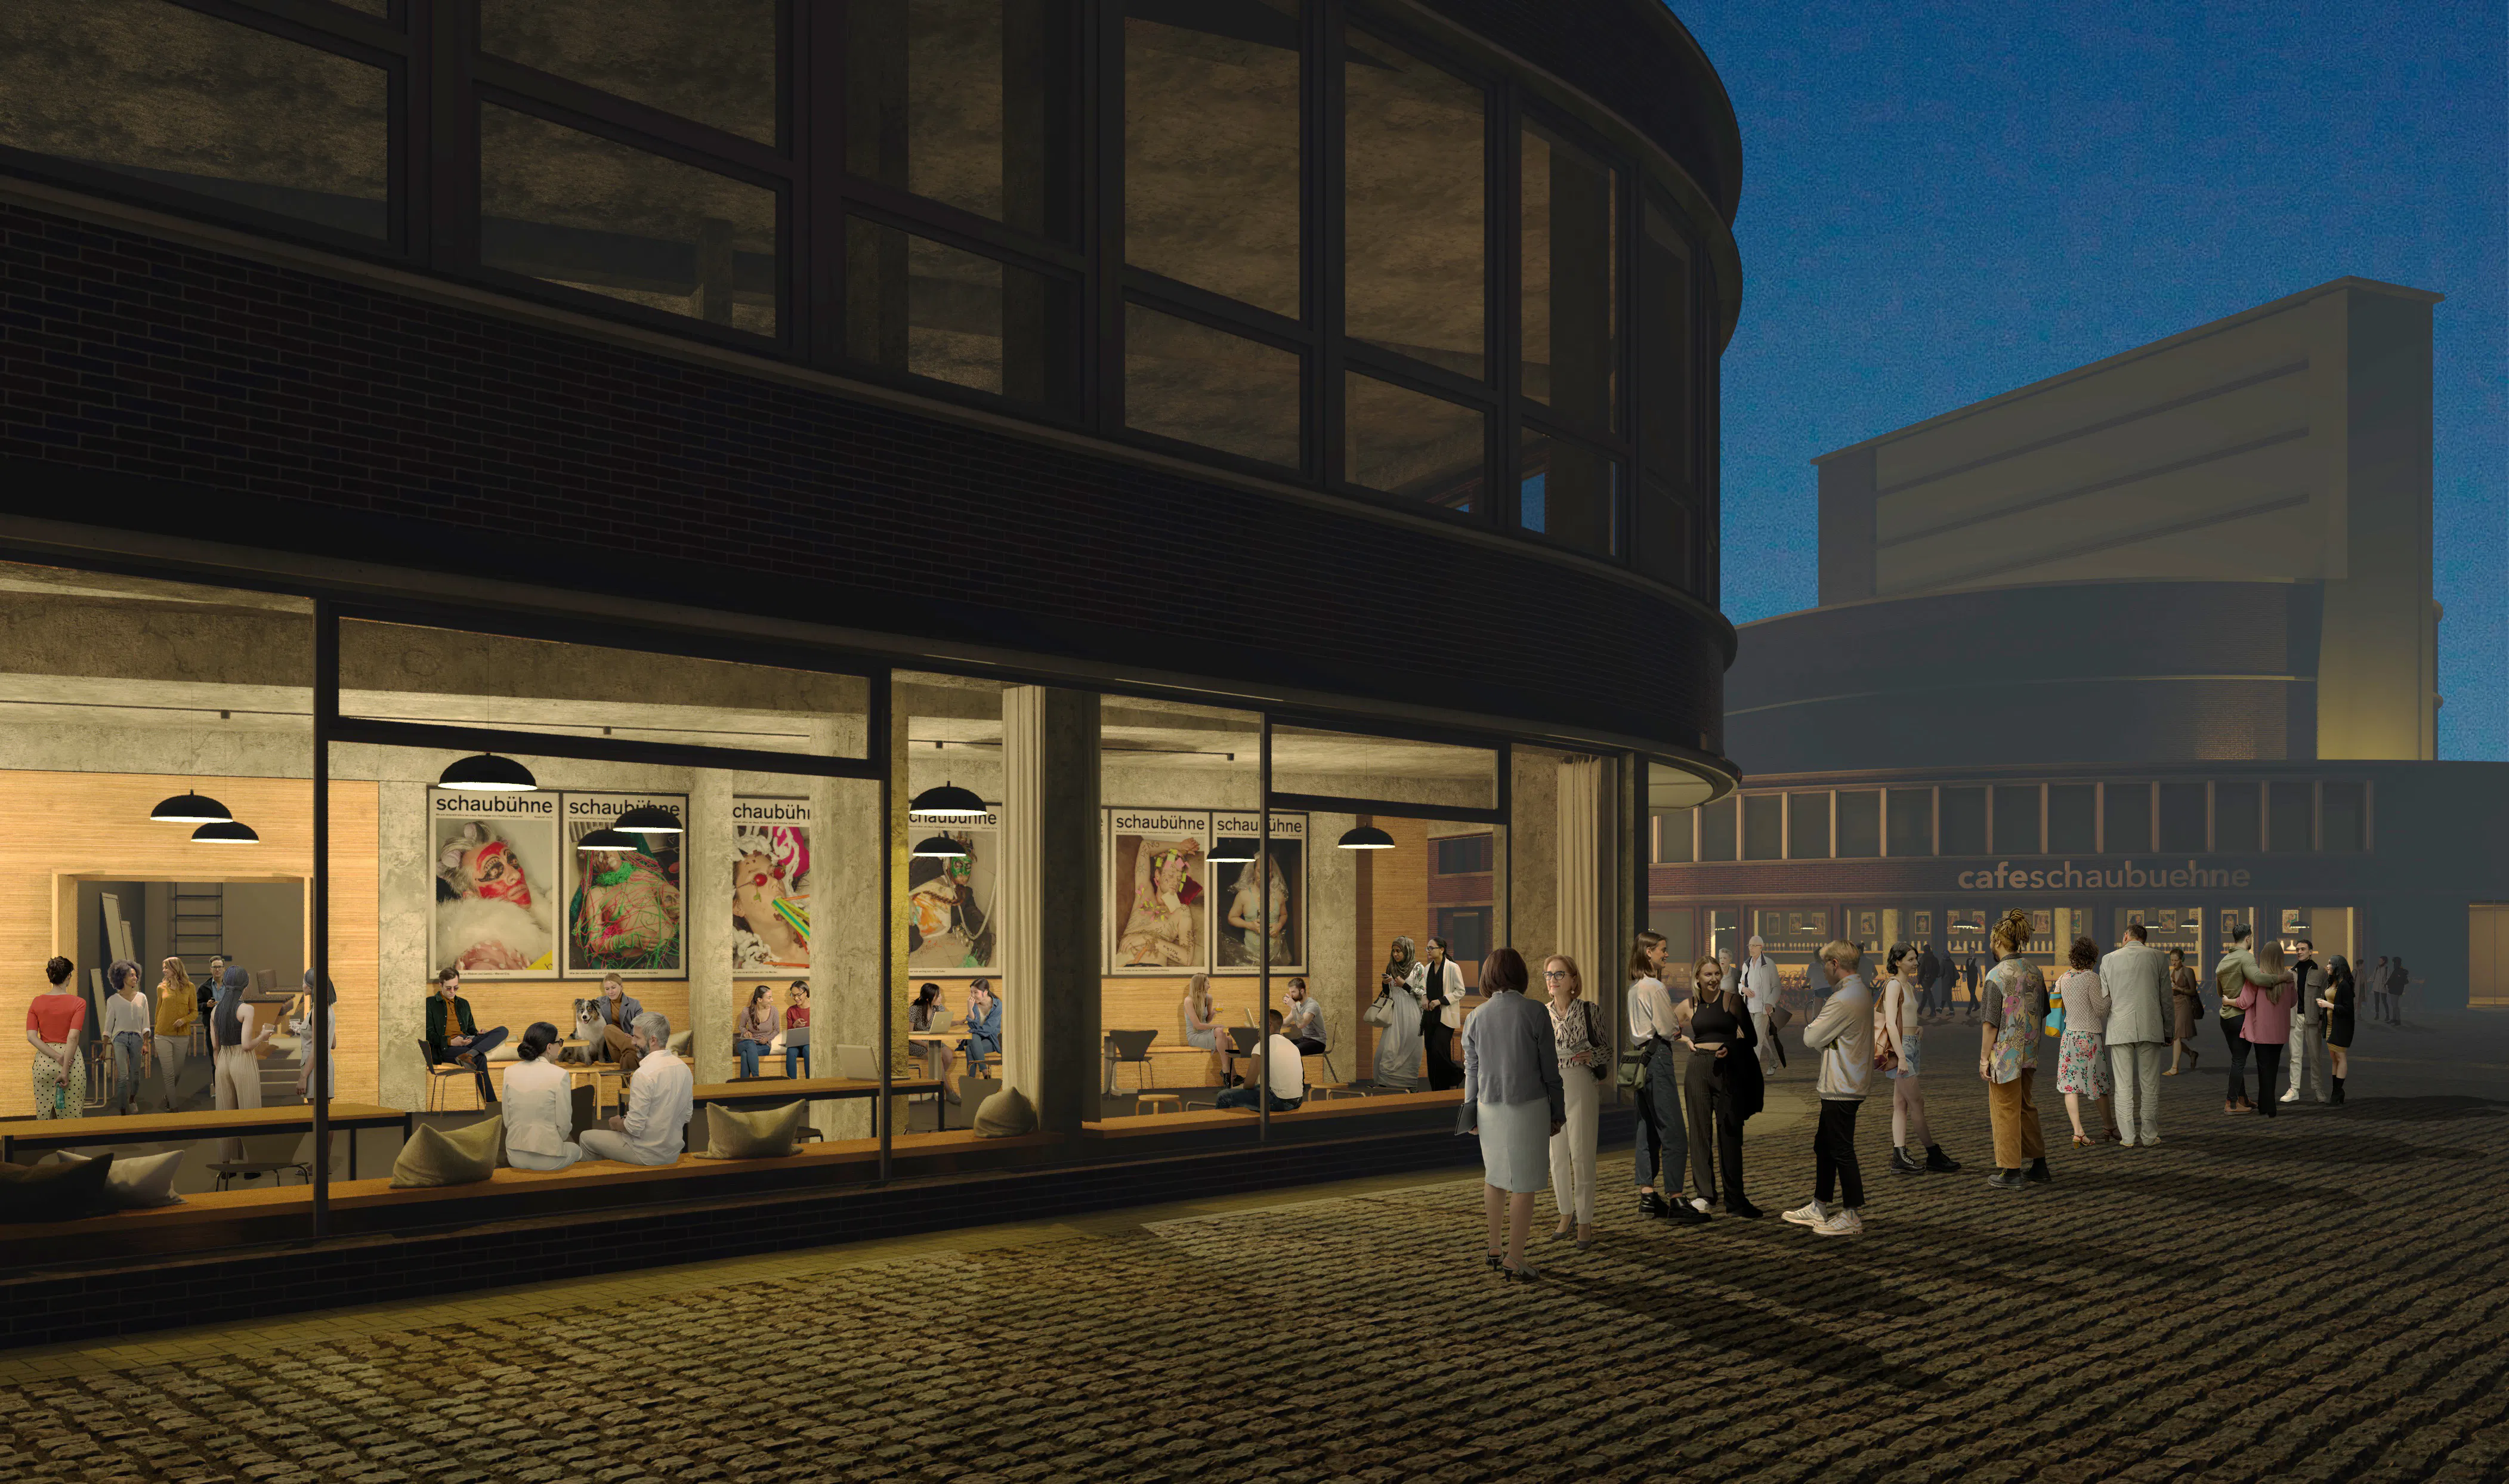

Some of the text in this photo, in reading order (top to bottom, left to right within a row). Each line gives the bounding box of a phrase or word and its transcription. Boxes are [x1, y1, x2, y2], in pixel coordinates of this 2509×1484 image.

[436, 795, 553, 813] schaubühne
[1116, 814, 1205, 830] schaubühne
[1217, 817, 1302, 833] schauühne
[1958, 861, 2251, 889] cafeschaubuehne
